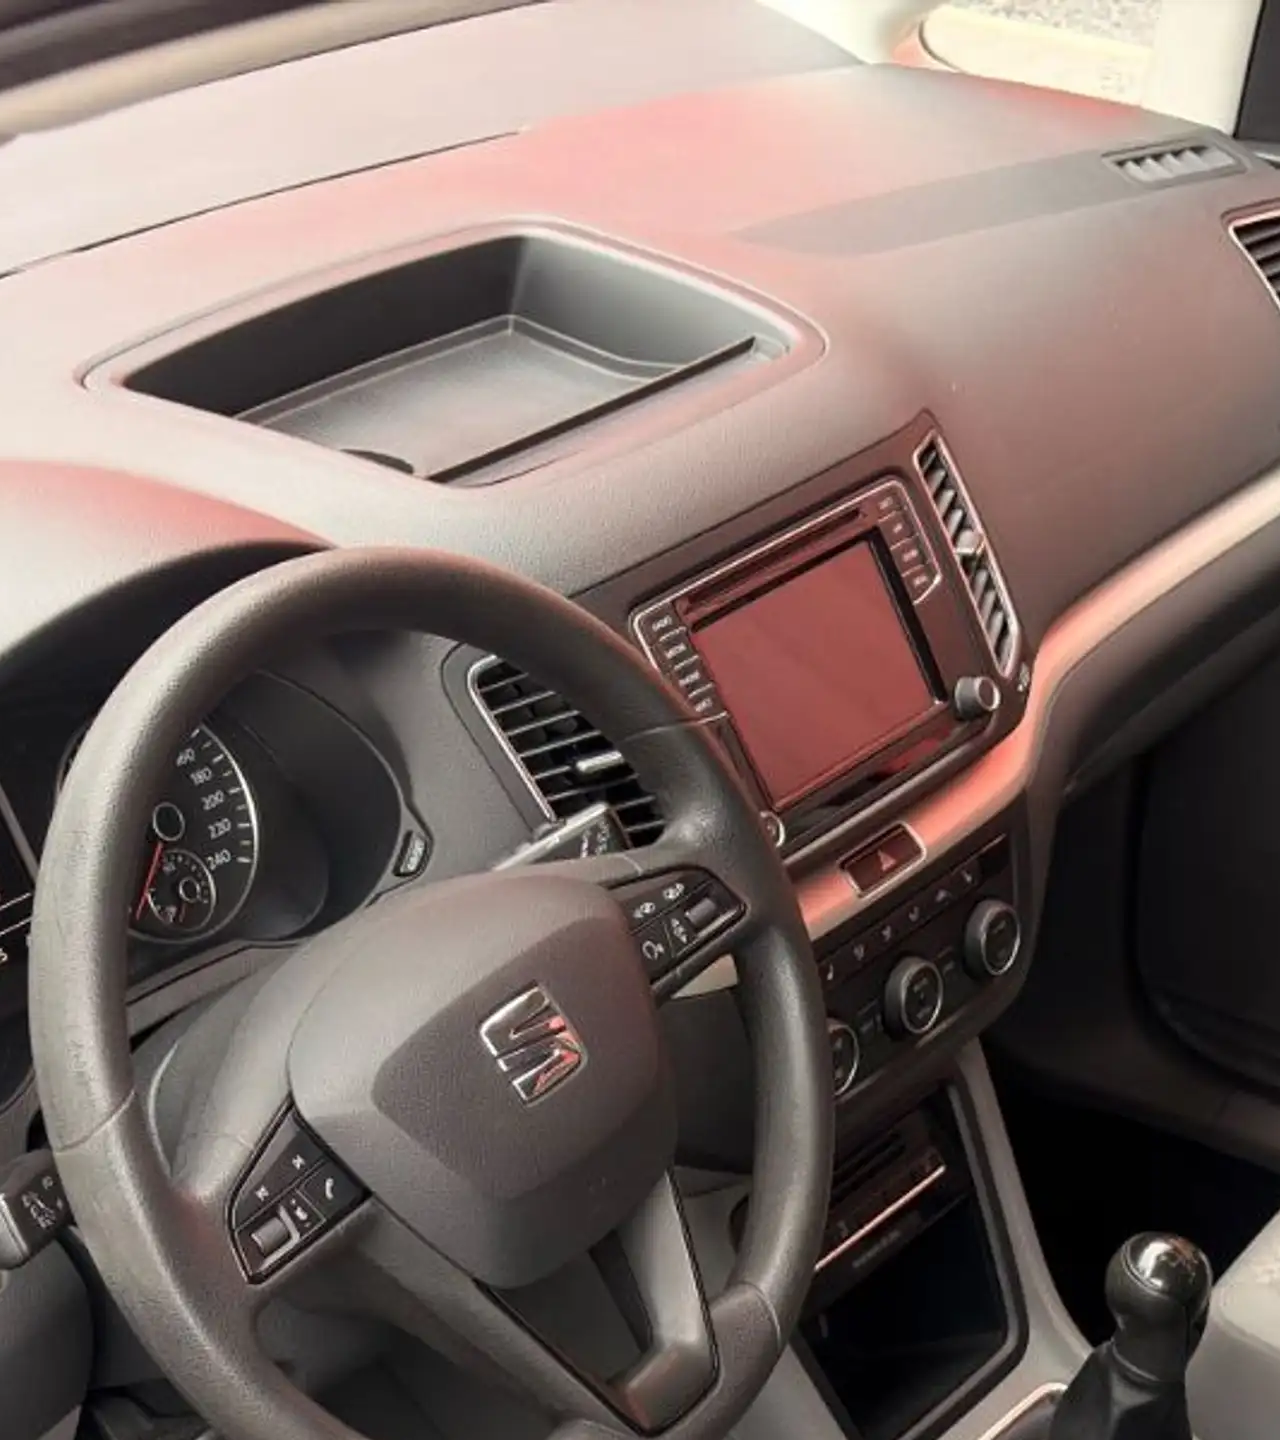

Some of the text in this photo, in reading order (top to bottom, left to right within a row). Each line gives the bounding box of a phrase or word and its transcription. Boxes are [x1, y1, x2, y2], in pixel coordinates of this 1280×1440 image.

[190, 767, 212, 785] 180
[201, 790, 225, 811] 200
[208, 817, 231, 840] 220
[206, 849, 232, 871] 240
